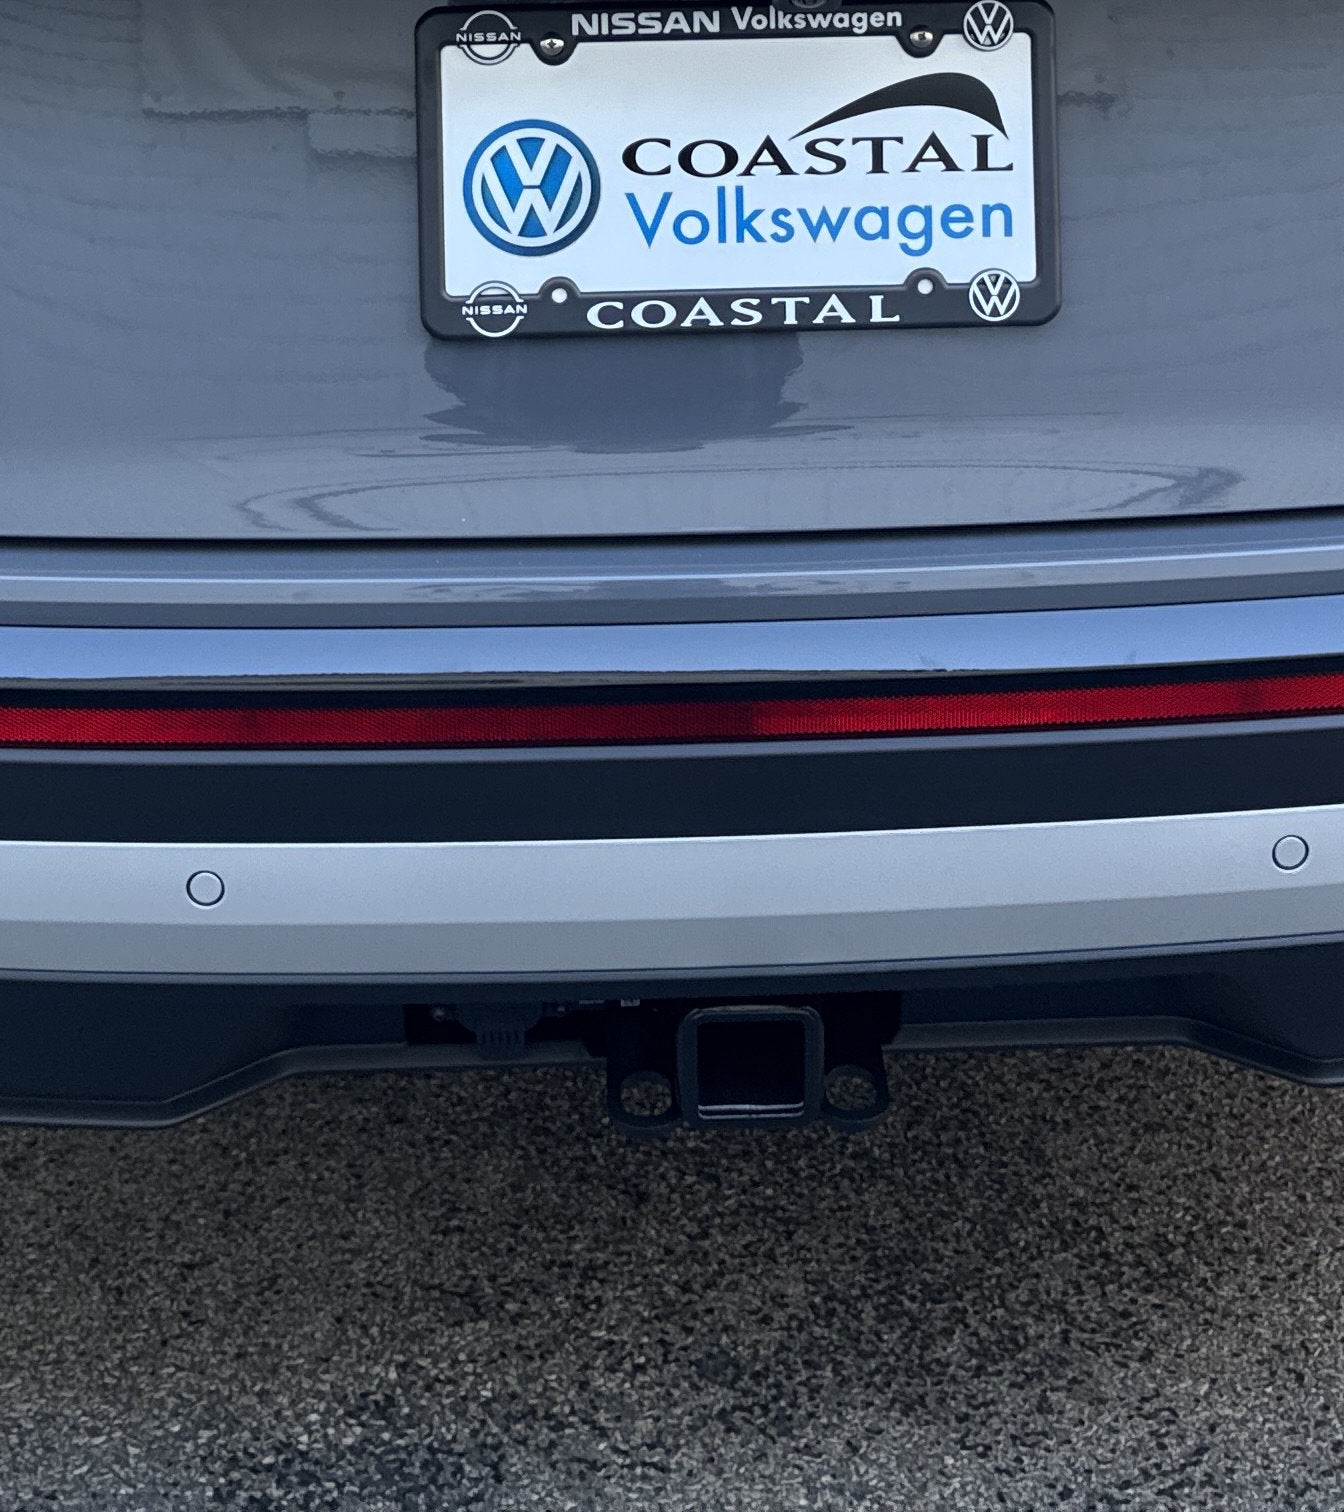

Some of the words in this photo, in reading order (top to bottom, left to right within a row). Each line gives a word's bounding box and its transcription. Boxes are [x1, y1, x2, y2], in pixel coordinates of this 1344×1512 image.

[456, 32, 522, 43] NISSAN
[571, 11, 721, 36] NISSAN
[731, 5, 903, 35] Volkswagen
[621, 131, 1014, 177] COASTAL
[624, 184, 1015, 257] Volkswagen
[461, 304, 528, 316] NISSAN
[586, 293, 901, 330] COASTAL
